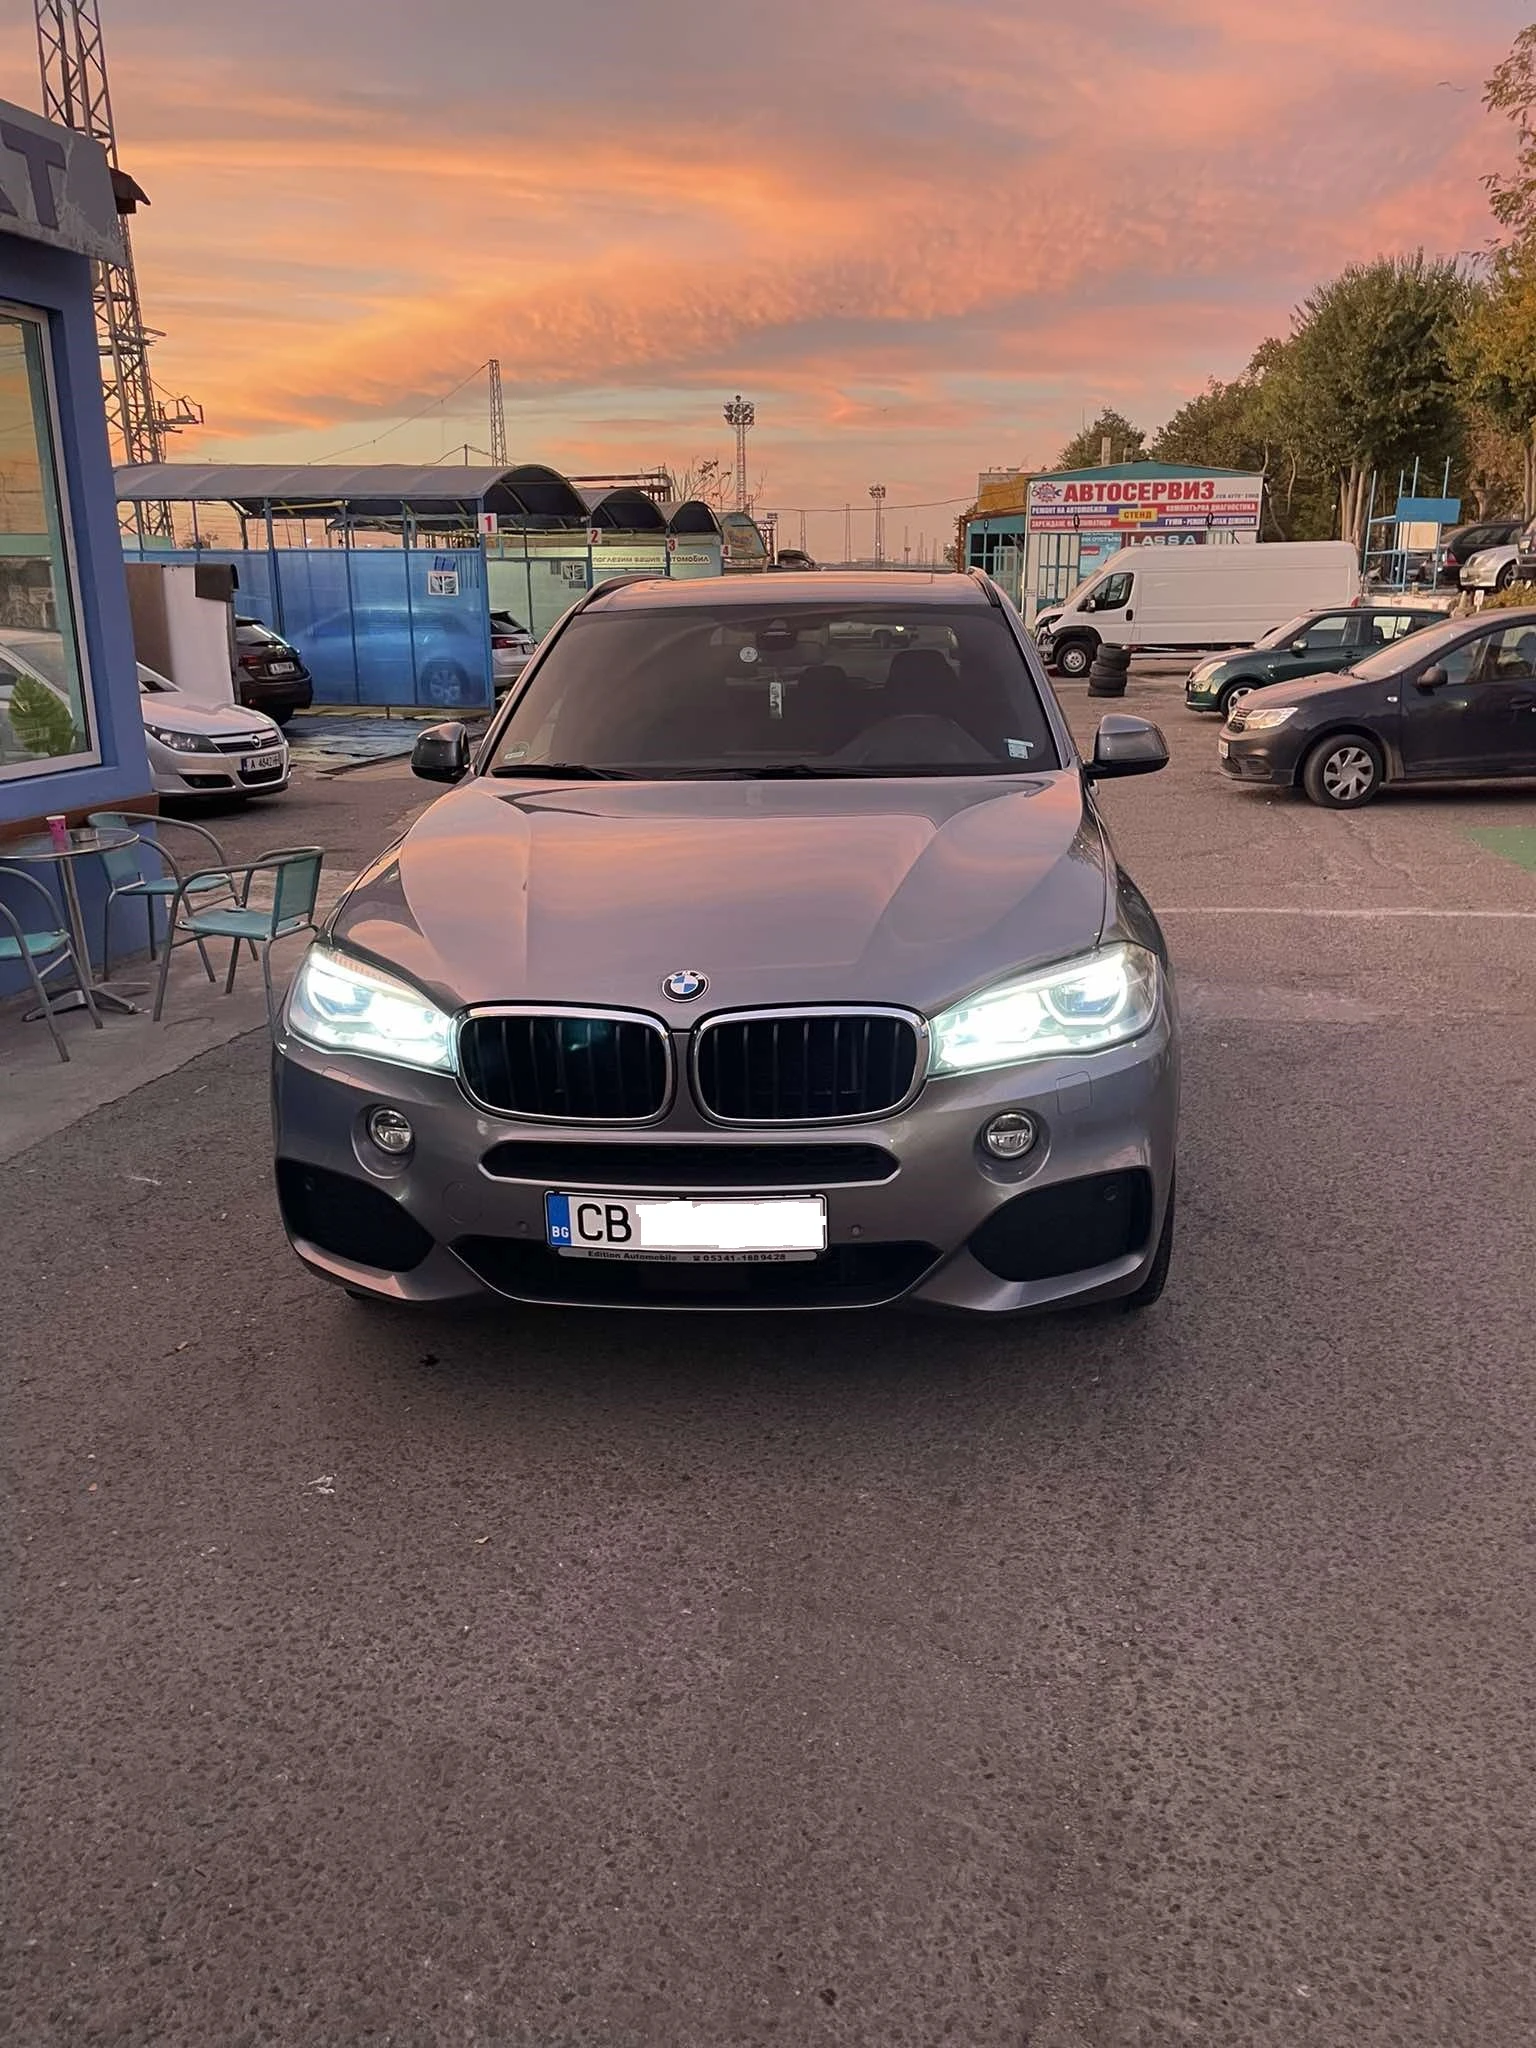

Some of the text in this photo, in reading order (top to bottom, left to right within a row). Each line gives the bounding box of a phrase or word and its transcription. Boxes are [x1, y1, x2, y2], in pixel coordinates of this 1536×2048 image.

[1063, 481, 1216, 502] АВТОСЕРВИЗ
[1210, 503, 1256, 511] ДИАГНОСТИКА
[1123, 511, 1153, 520] СТЕНД
[484, 515, 494, 533] 1
[590, 530, 599, 544] 2
[1130, 535, 1197, 546] LASSA
[668, 539, 676, 551] 3
[552, 1203, 632, 1243] BG CB
[588, 1250, 620, 1259] Edition
[624, 1252, 677, 1261] Automobile
